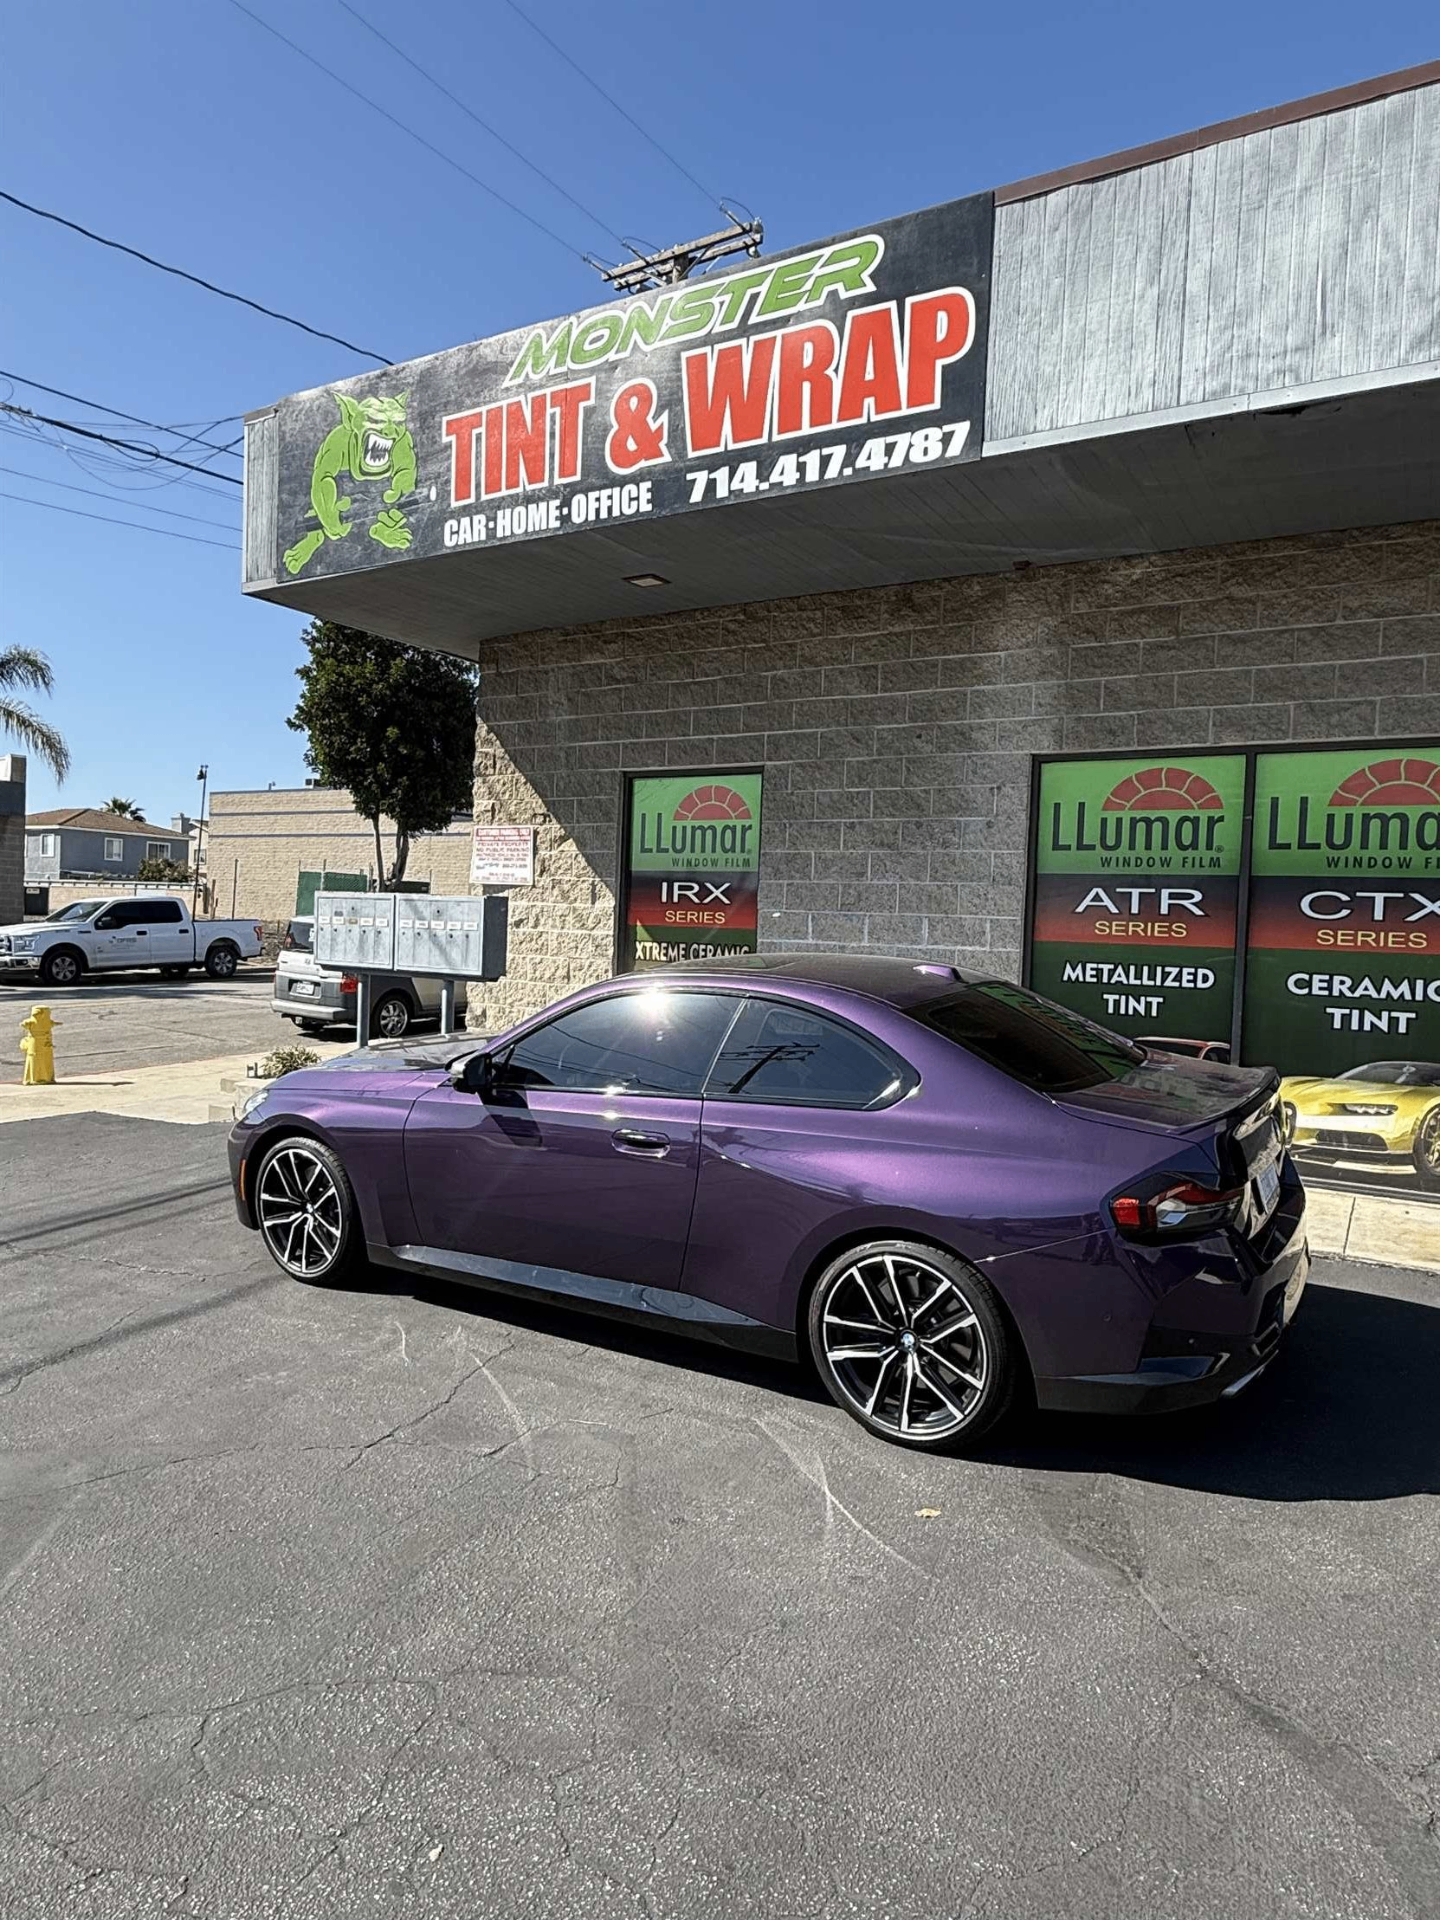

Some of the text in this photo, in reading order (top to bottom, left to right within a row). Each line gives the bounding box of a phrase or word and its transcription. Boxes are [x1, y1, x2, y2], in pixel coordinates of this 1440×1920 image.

[502, 233, 885, 388] MONSTER
[442, 286, 976, 508] TINT & WRAP
[686, 420, 971, 504] 714.417.4787
[671, 857, 751, 868] WINDOW FILM
[1101, 856, 1222, 869] WINDOW FILM
[1326, 856, 1413, 869] WINDOW
[660, 881, 732, 905] IRX
[1073, 886, 1208, 917] ATR
[664, 910, 726, 925] SERIES
[1094, 920, 1188, 938] SERIES
[634, 940, 687, 962] XTREME
[1315, 929, 1428, 949] SERIES
[1062, 961, 1216, 989] METALLIZED
[1103, 993, 1164, 1018] TINT
[1325, 1006, 1417, 1034] TINT
